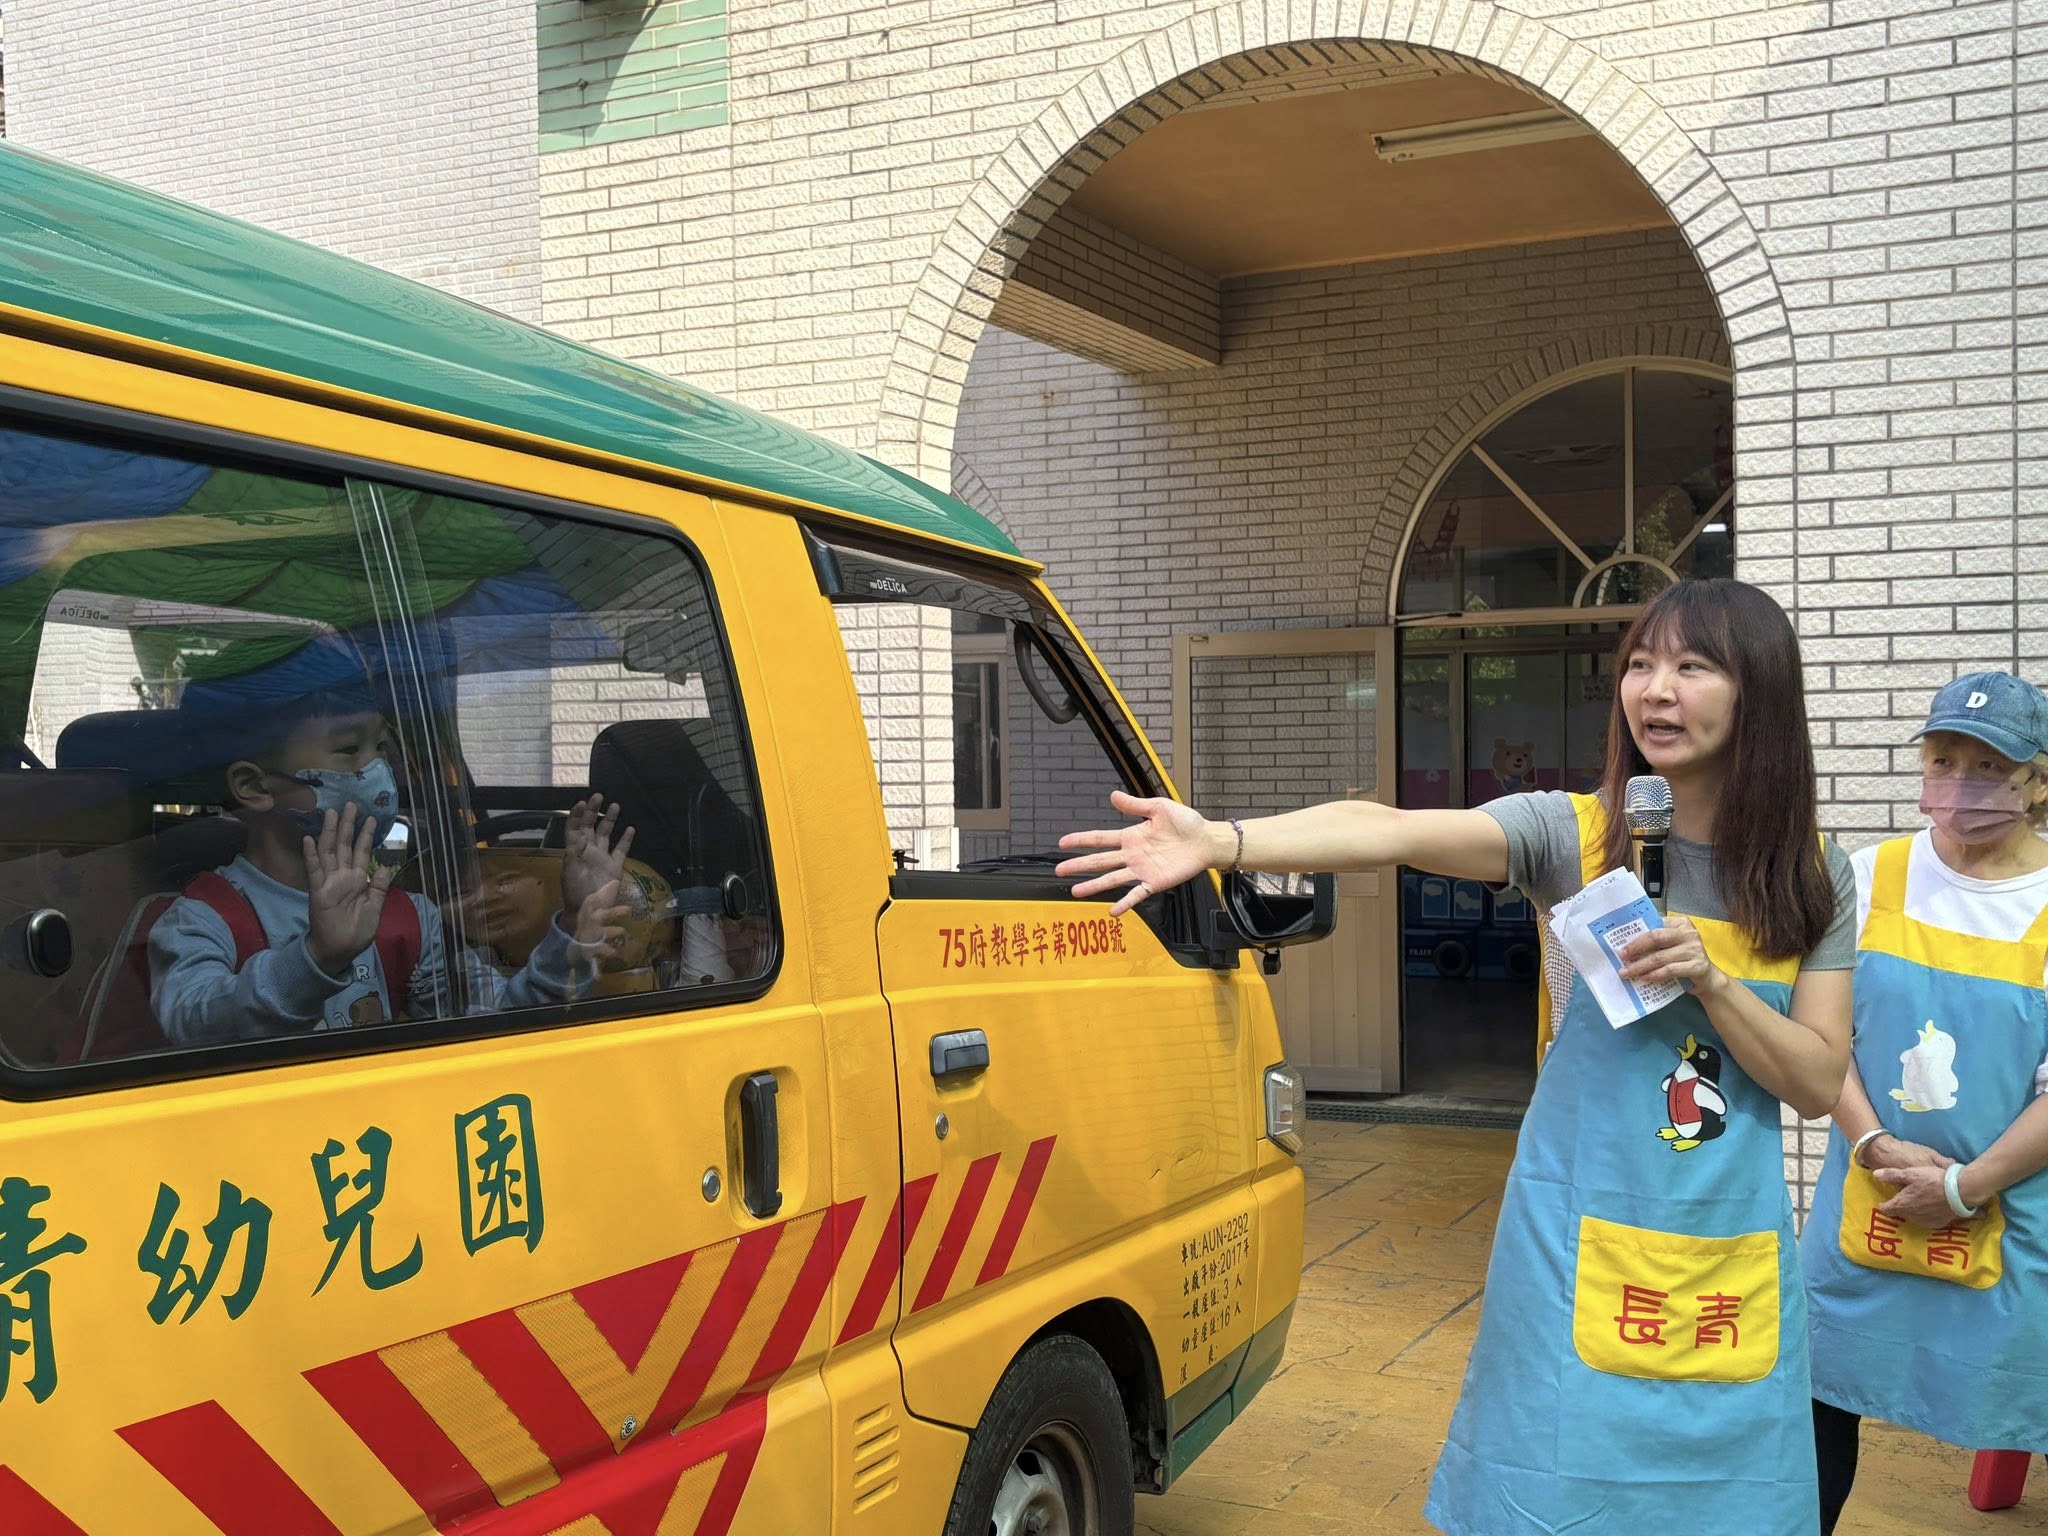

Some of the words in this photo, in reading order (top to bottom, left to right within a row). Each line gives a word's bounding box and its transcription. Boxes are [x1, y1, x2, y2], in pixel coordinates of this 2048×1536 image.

[877, 579, 908, 594] DELICA
[1965, 691, 1988, 709] D
[939, 916, 1126, 968] 75府教學字第9038號
[1613, 1284, 1743, 1349] 長青
